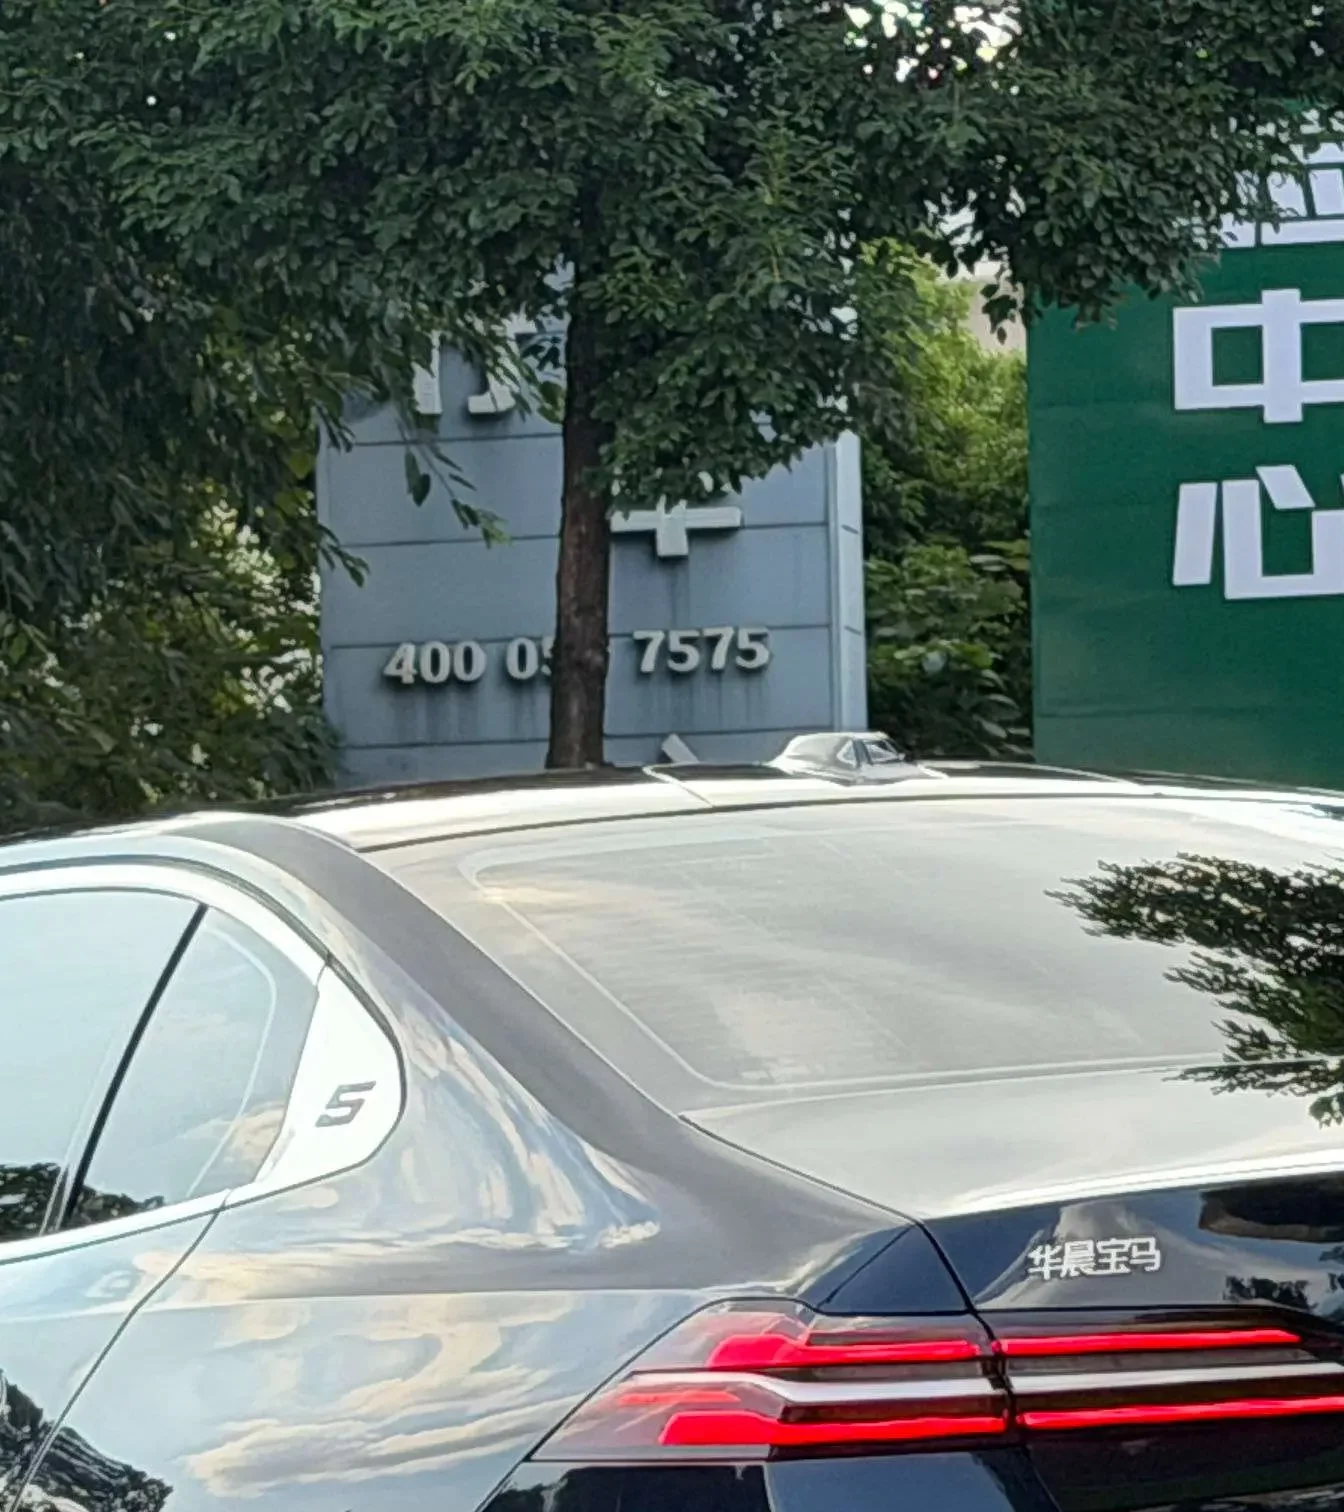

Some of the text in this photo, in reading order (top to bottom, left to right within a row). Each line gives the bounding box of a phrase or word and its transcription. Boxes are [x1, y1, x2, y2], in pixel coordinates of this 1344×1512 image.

[383, 640, 487, 684] 400
[632, 625, 771, 674] 7575
[1027, 1235, 1161, 1281] 华晨宝马
